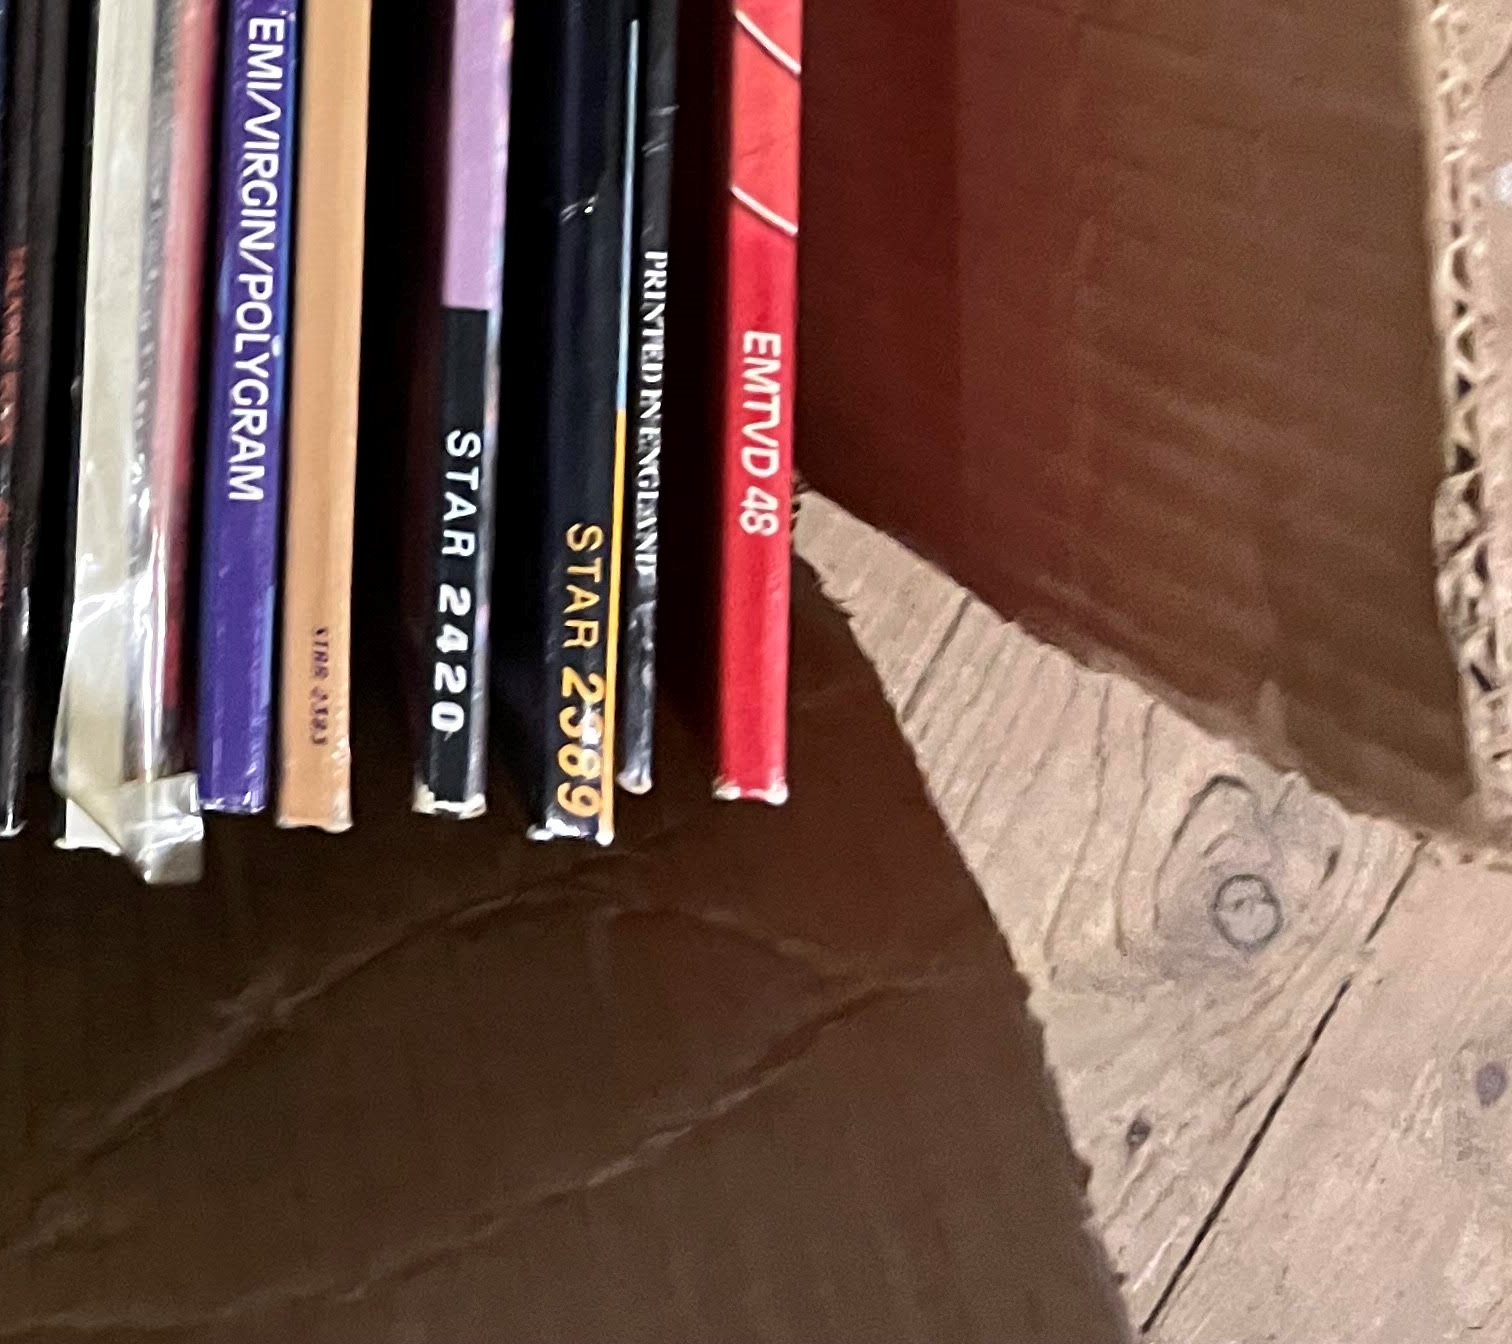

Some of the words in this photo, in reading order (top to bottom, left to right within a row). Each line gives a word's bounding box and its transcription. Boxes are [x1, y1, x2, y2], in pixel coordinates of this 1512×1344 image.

[226, 15, 286, 502] EMI/VIRGIN/POLYGRAM
[638, 249, 670, 383] PRINTED
[637, 388, 664, 422] IN
[739, 329, 781, 476] EMTVD
[440, 429, 482, 558] STAR
[632, 427, 662, 575] ENGLAND
[738, 485, 780, 538] 48
[560, 522, 604, 650] STAR
[430, 582, 468, 734] 2420
[555, 665, 606, 819] 2389
